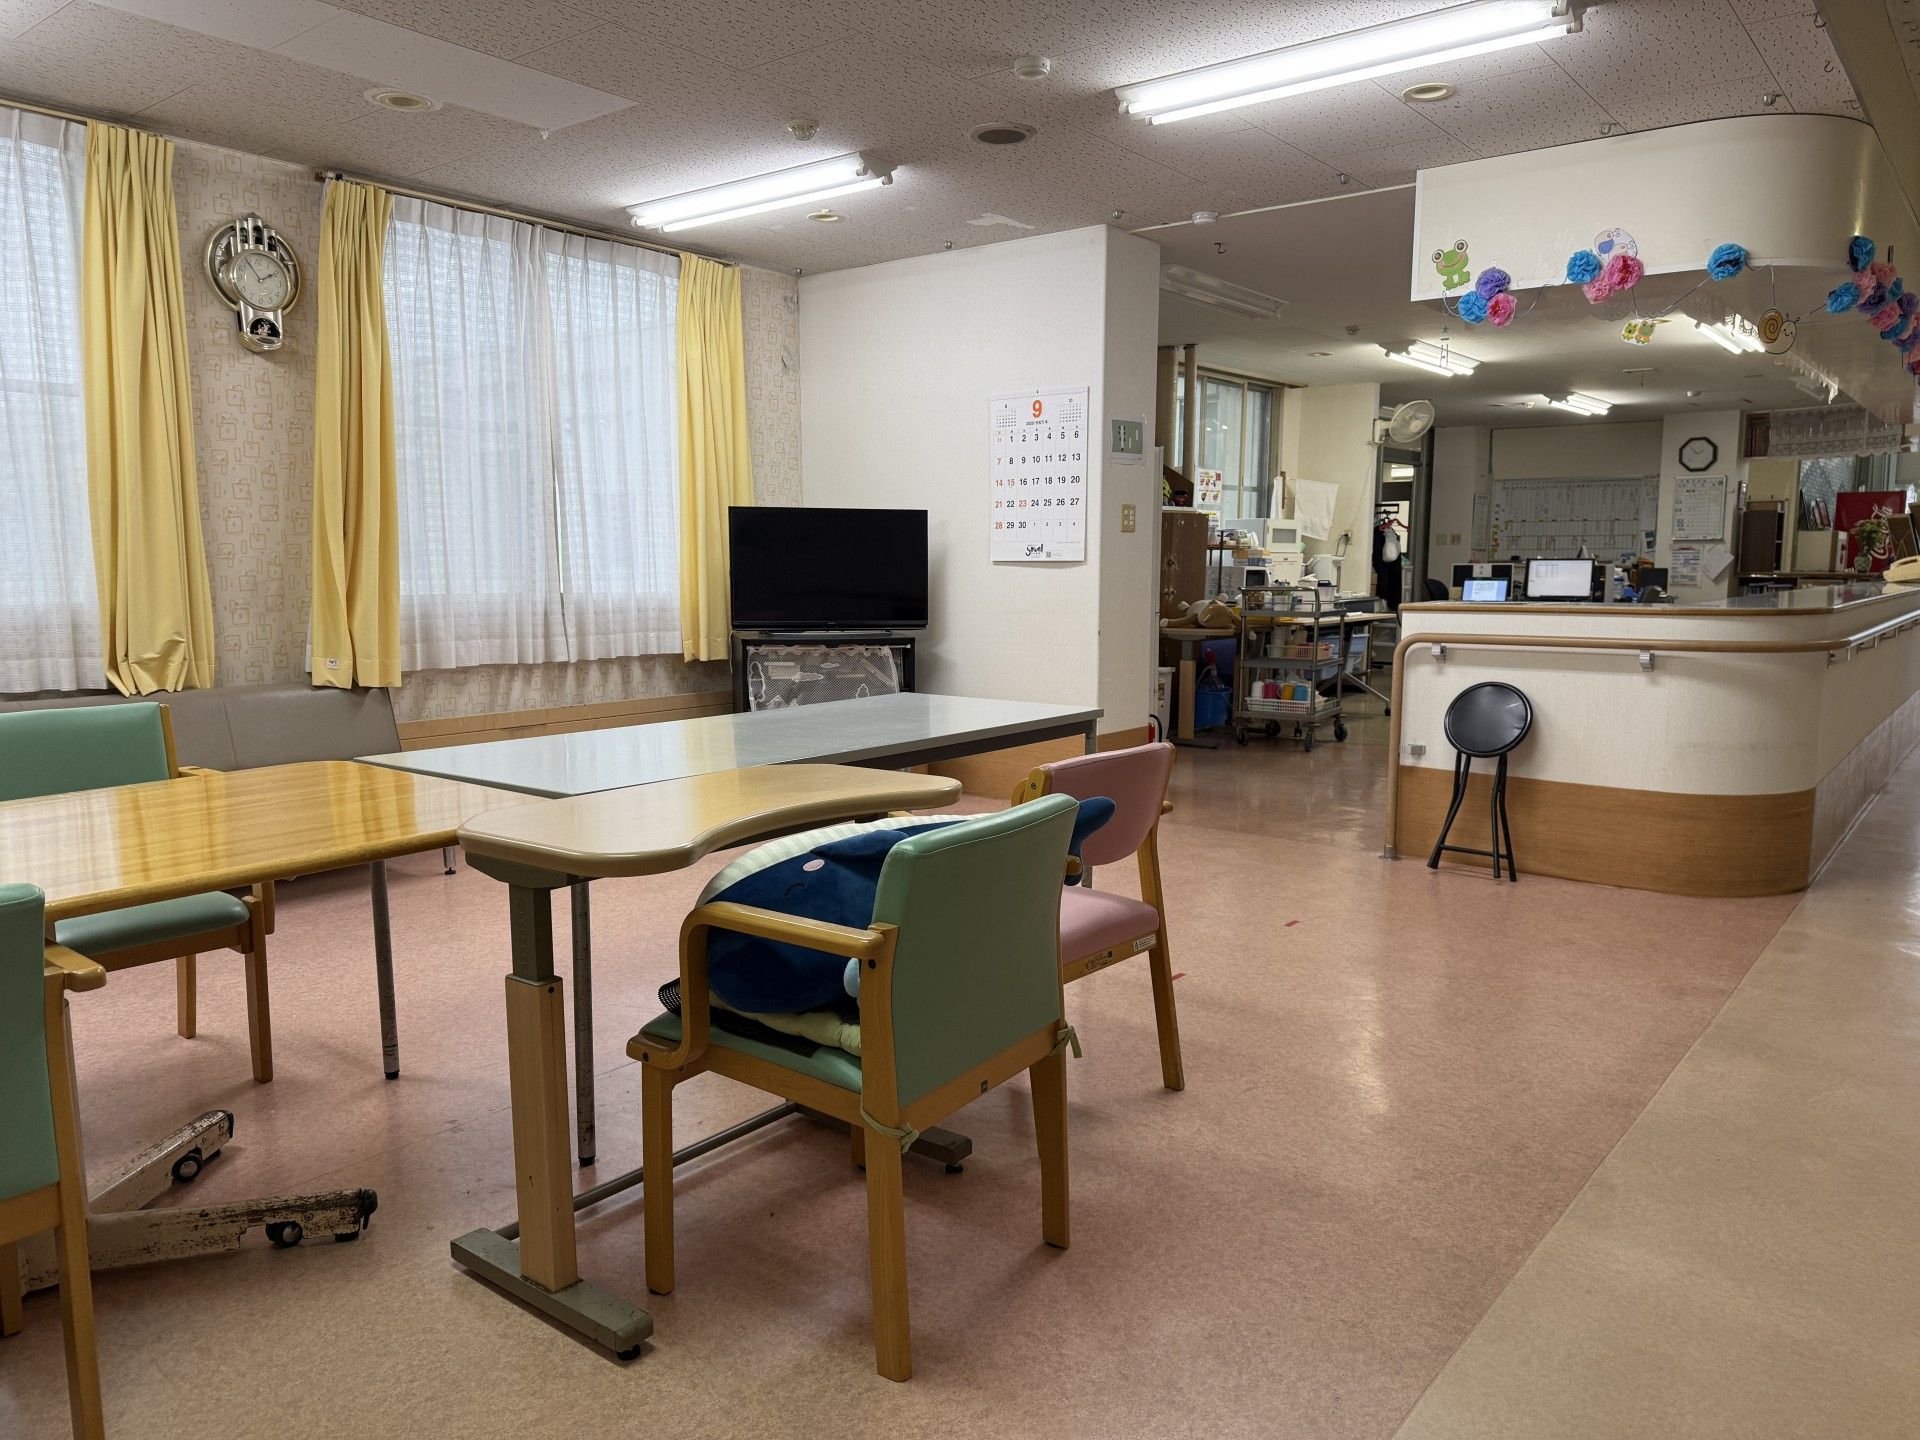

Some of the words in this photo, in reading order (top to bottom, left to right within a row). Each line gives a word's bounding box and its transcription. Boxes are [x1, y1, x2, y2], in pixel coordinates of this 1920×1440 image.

[1033, 400, 1042, 418] 9
[1009, 457, 1013, 465] 8
[1072, 453, 1080, 461] 13
[1058, 476, 1066, 484] 19
[1031, 499, 1039, 507] 24
[1056, 498, 1065, 506] 26
